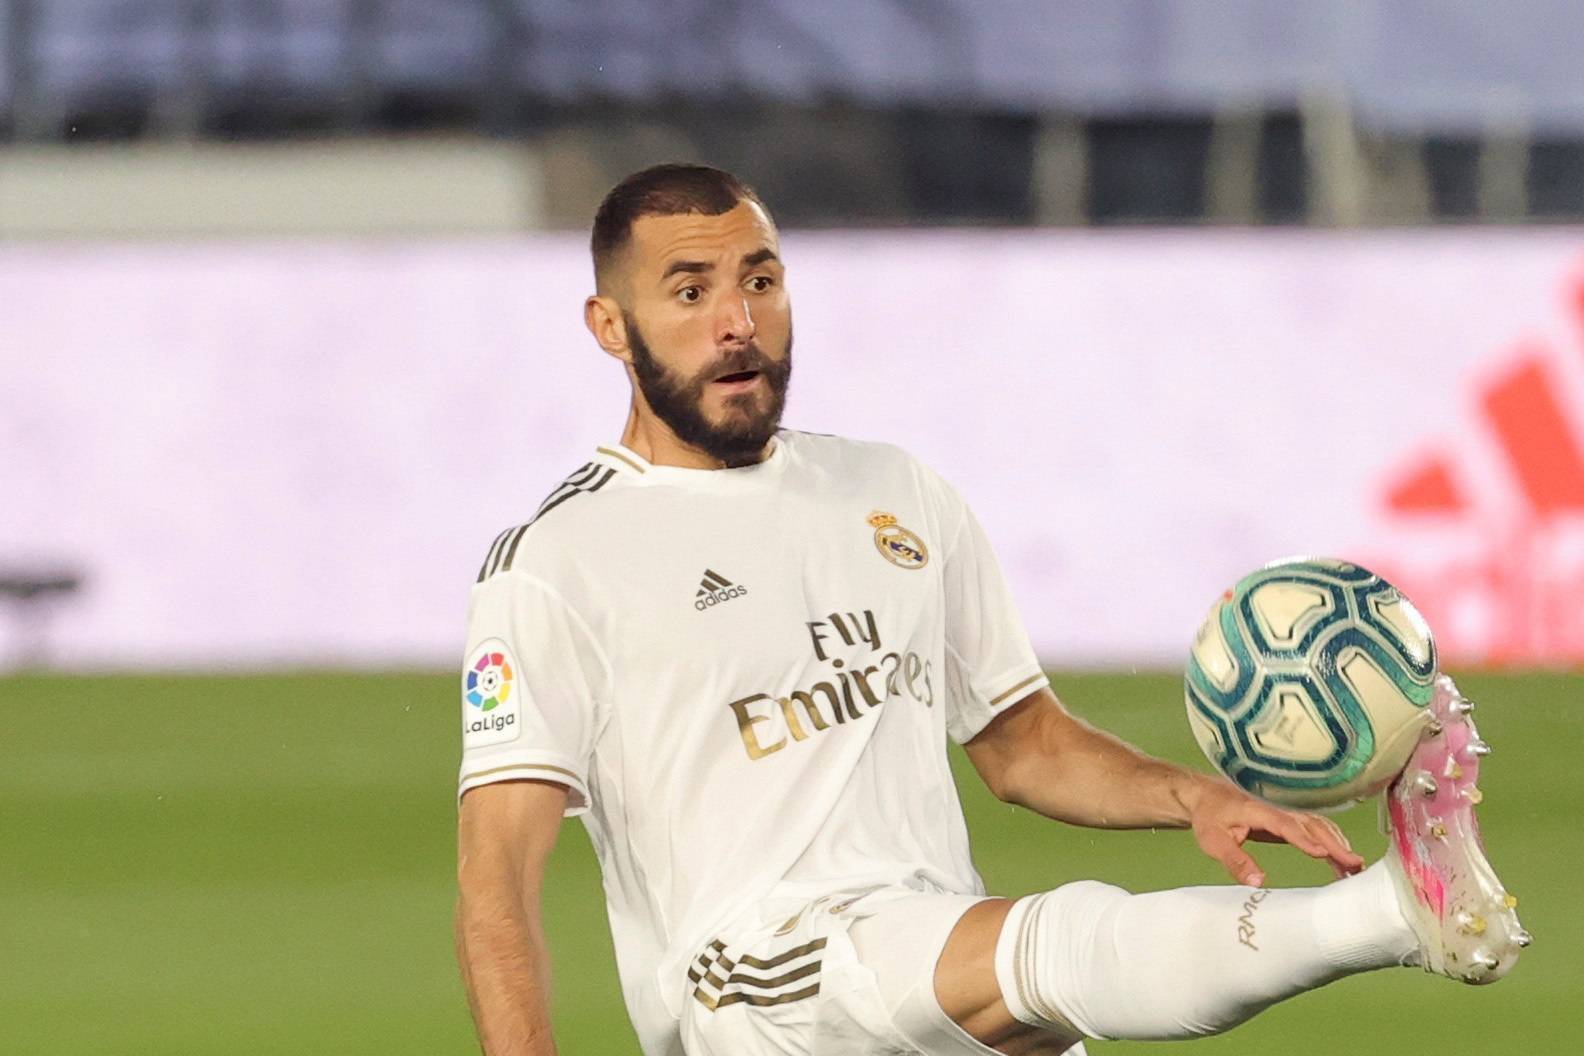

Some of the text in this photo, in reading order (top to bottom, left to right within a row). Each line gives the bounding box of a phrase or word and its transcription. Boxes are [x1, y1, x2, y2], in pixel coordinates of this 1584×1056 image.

[694, 584, 748, 611] adidas
[806, 609, 882, 662] Fly
[1238, 888, 1272, 951] RMC
